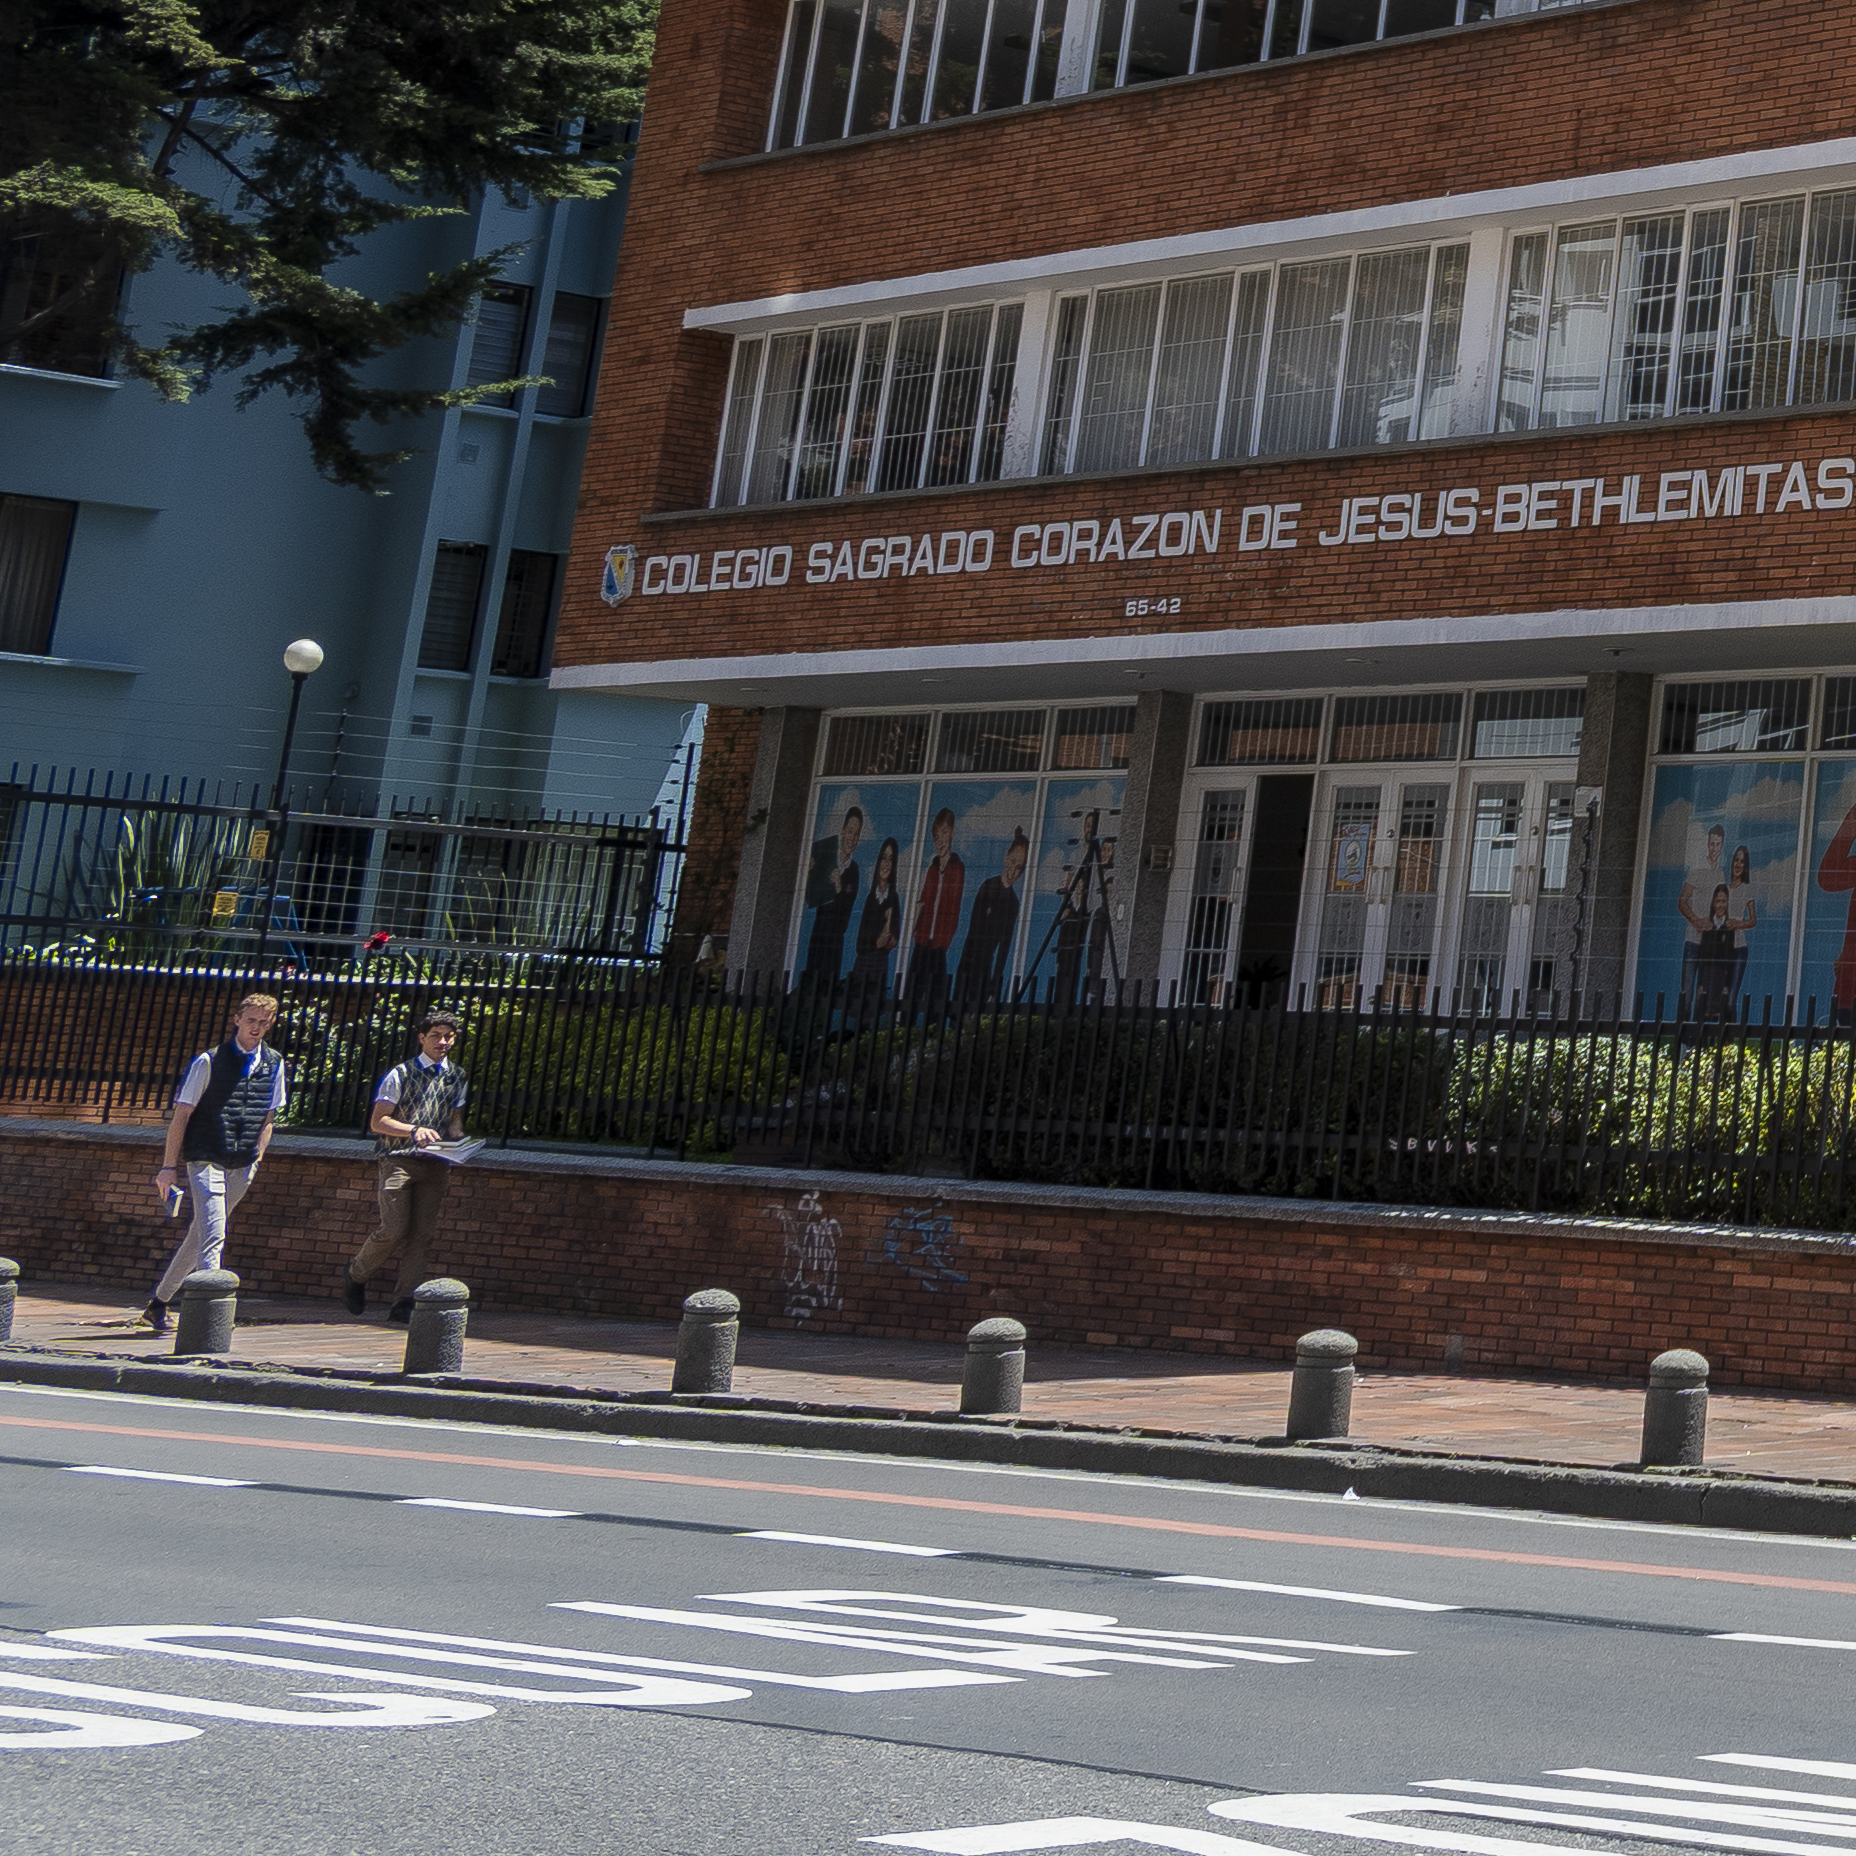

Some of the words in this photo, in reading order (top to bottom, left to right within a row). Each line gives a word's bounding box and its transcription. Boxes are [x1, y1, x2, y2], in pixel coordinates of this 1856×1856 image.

[641, 544, 793, 596] COLEGIO
[806, 529, 994, 585] SAGRADO
[1011, 507, 1223, 568] CORAZON
[1237, 501, 1302, 552] DE
[1125, 597, 1181, 618] 65-42
